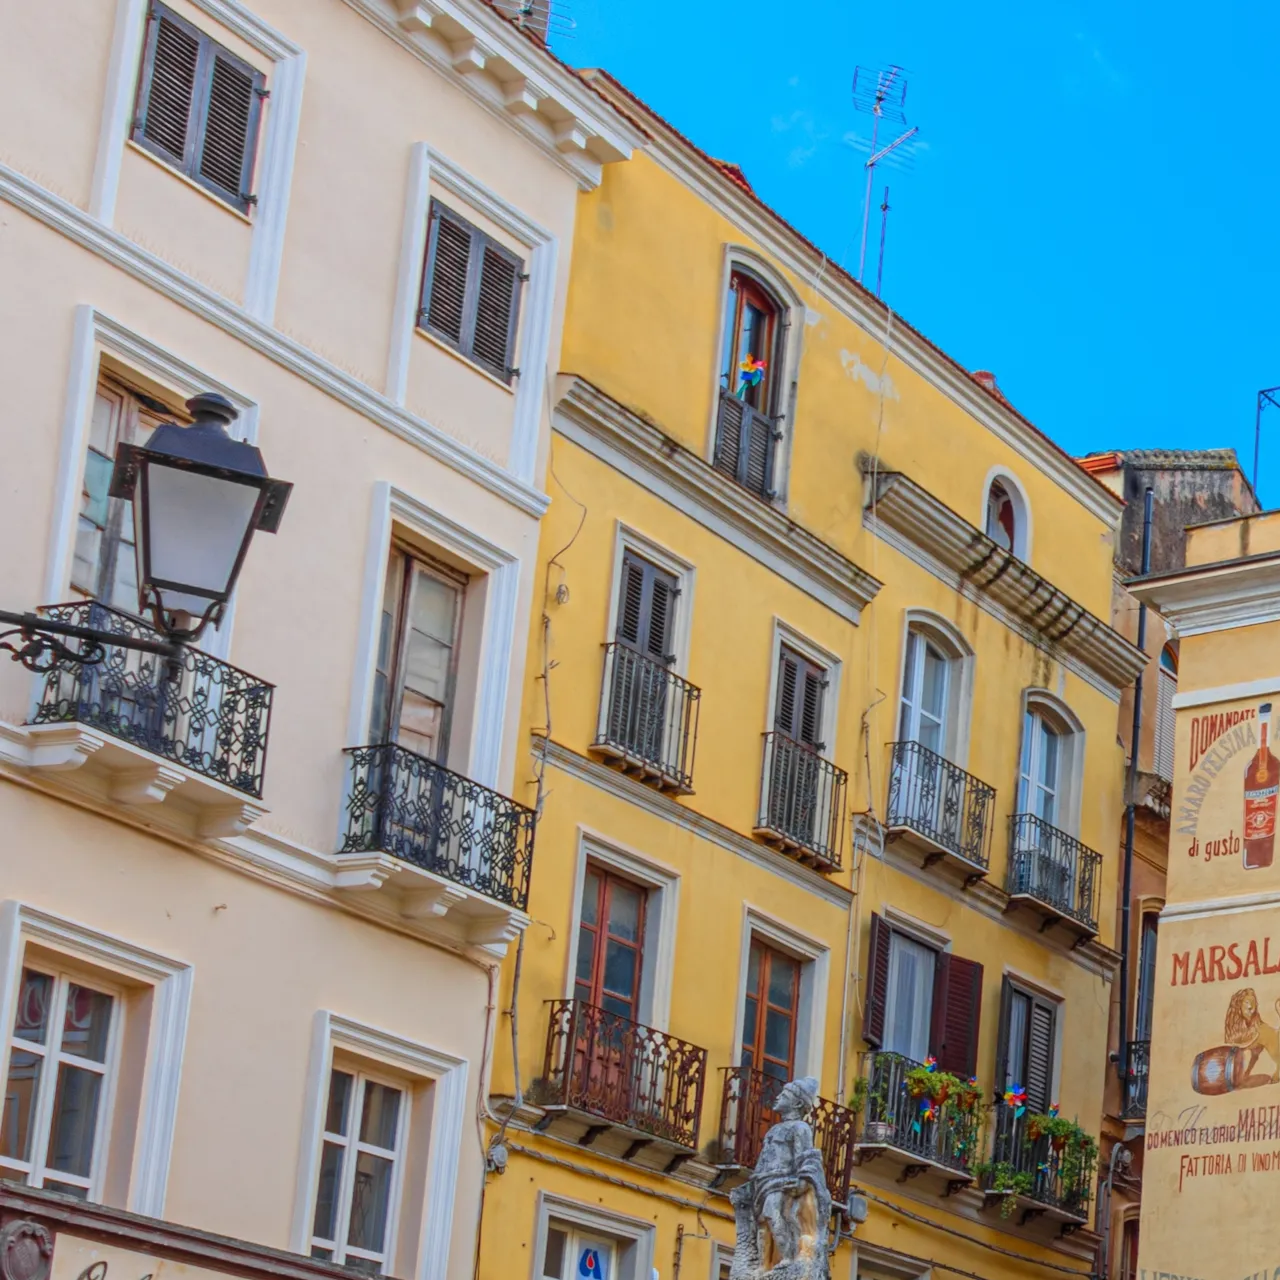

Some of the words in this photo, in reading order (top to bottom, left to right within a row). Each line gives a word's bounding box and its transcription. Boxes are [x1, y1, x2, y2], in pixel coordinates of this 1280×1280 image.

[1189, 708, 1256, 773] DOMANDATE
[1176, 773, 1211, 836] AMARO
[1199, 722, 1257, 779] FELSINA
[1188, 836, 1200, 857] di
[1205, 829, 1241, 862] gusto
[1147, 1127, 1197, 1151] DOMENICO
[1199, 1124, 1236, 1146] FLORIO
[1179, 1153, 1232, 1193] FATTORIA
[1238, 1153, 1247, 1173] DI
